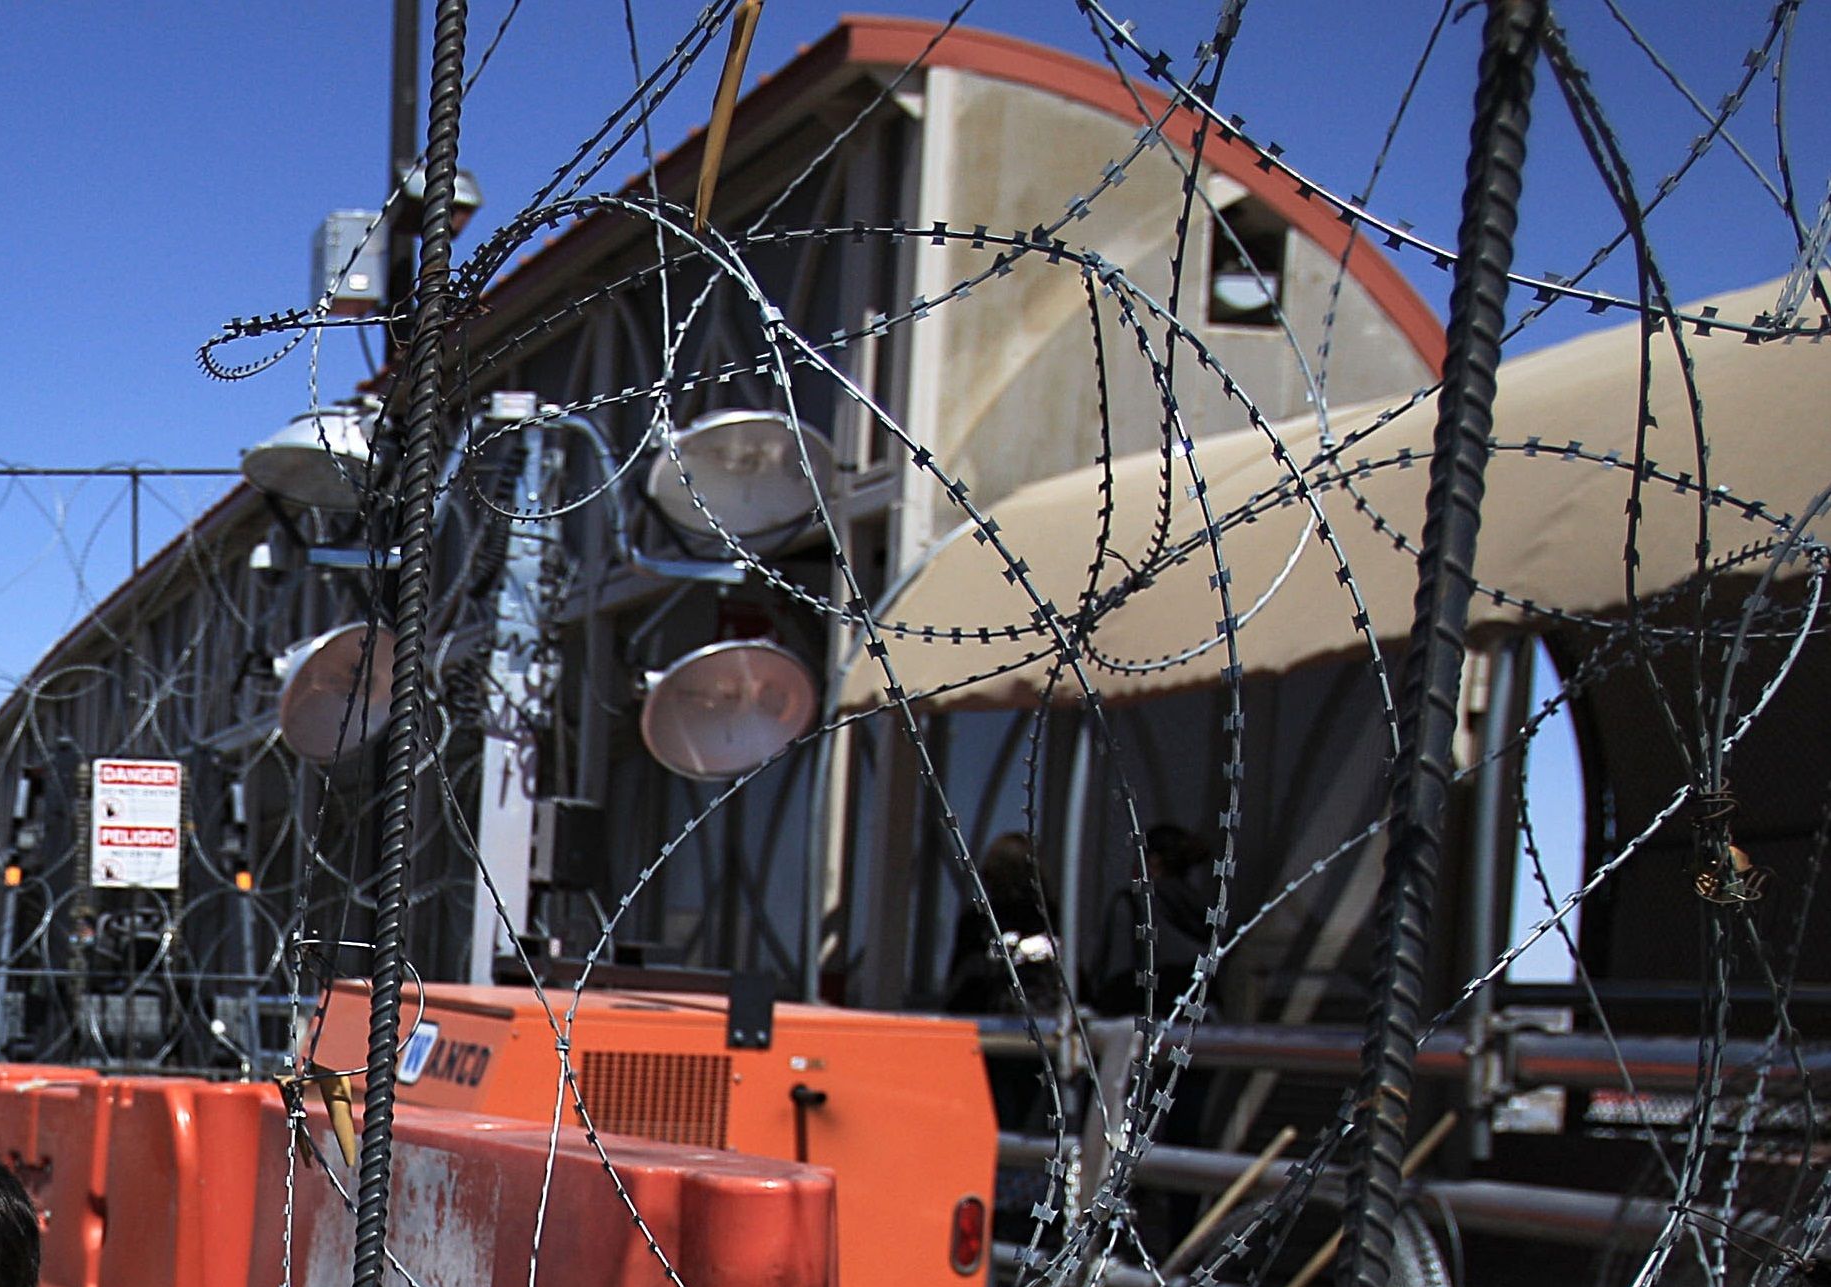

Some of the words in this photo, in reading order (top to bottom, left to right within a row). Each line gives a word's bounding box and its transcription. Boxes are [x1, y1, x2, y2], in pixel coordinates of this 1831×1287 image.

[103, 767, 175, 783] DANGER
[101, 829, 173, 845] PELIGRO
[403, 1033, 491, 1086] WANCO
